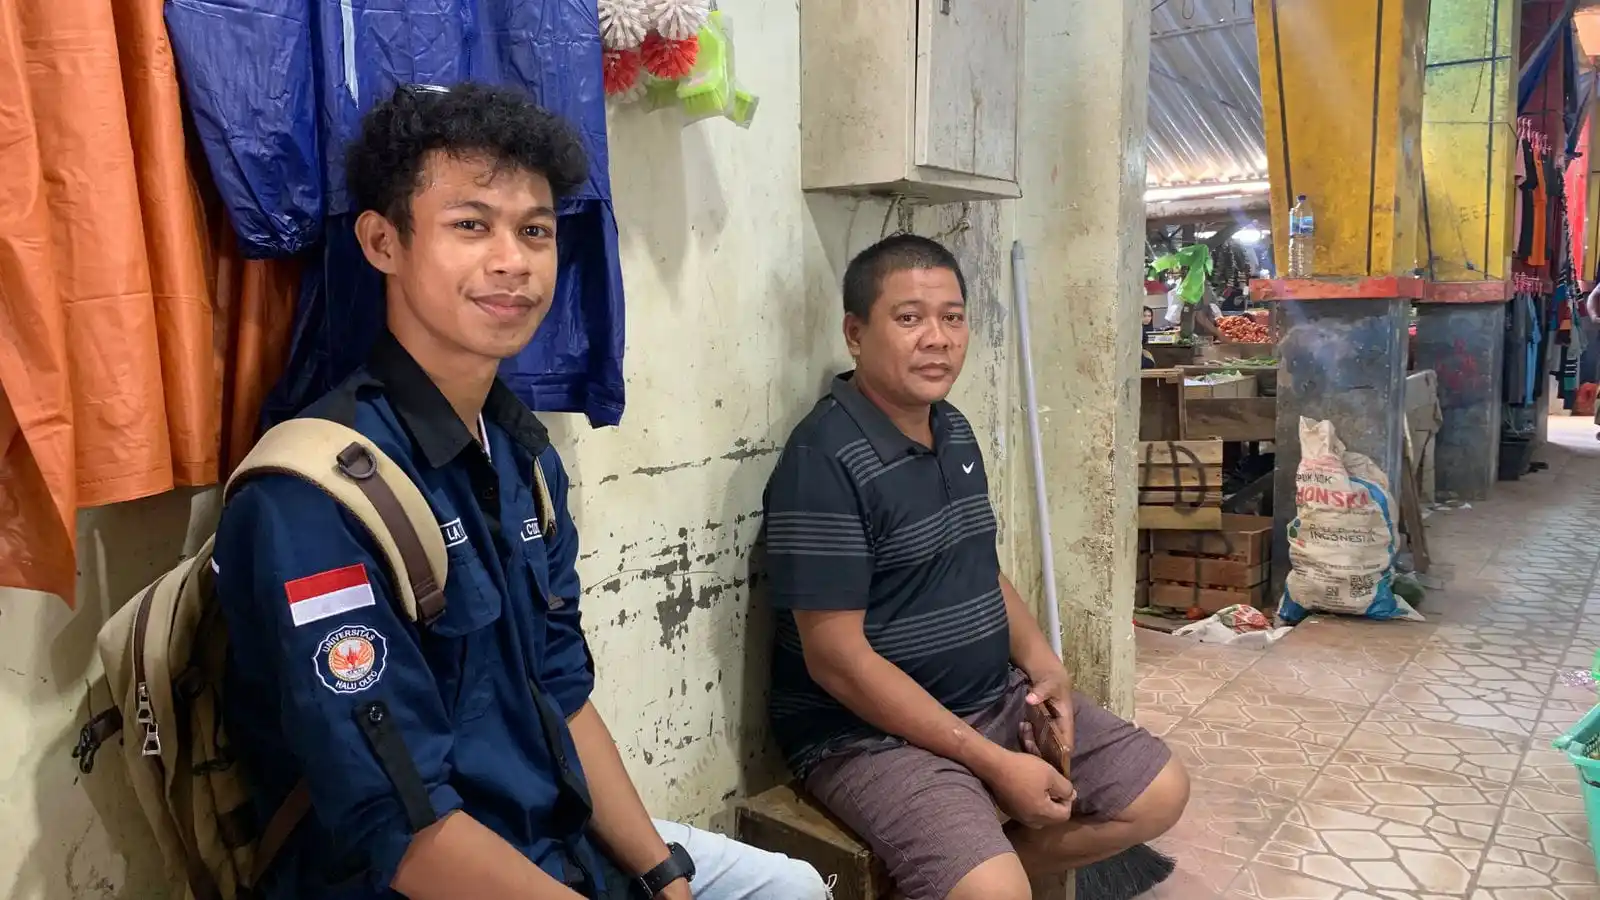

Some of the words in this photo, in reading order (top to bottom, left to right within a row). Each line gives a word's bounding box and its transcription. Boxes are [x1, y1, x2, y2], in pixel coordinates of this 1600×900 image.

[322, 629, 376, 653] UNIVERSITAS
[335, 680, 357, 690] HALU
[359, 670, 378, 688] OLEO
